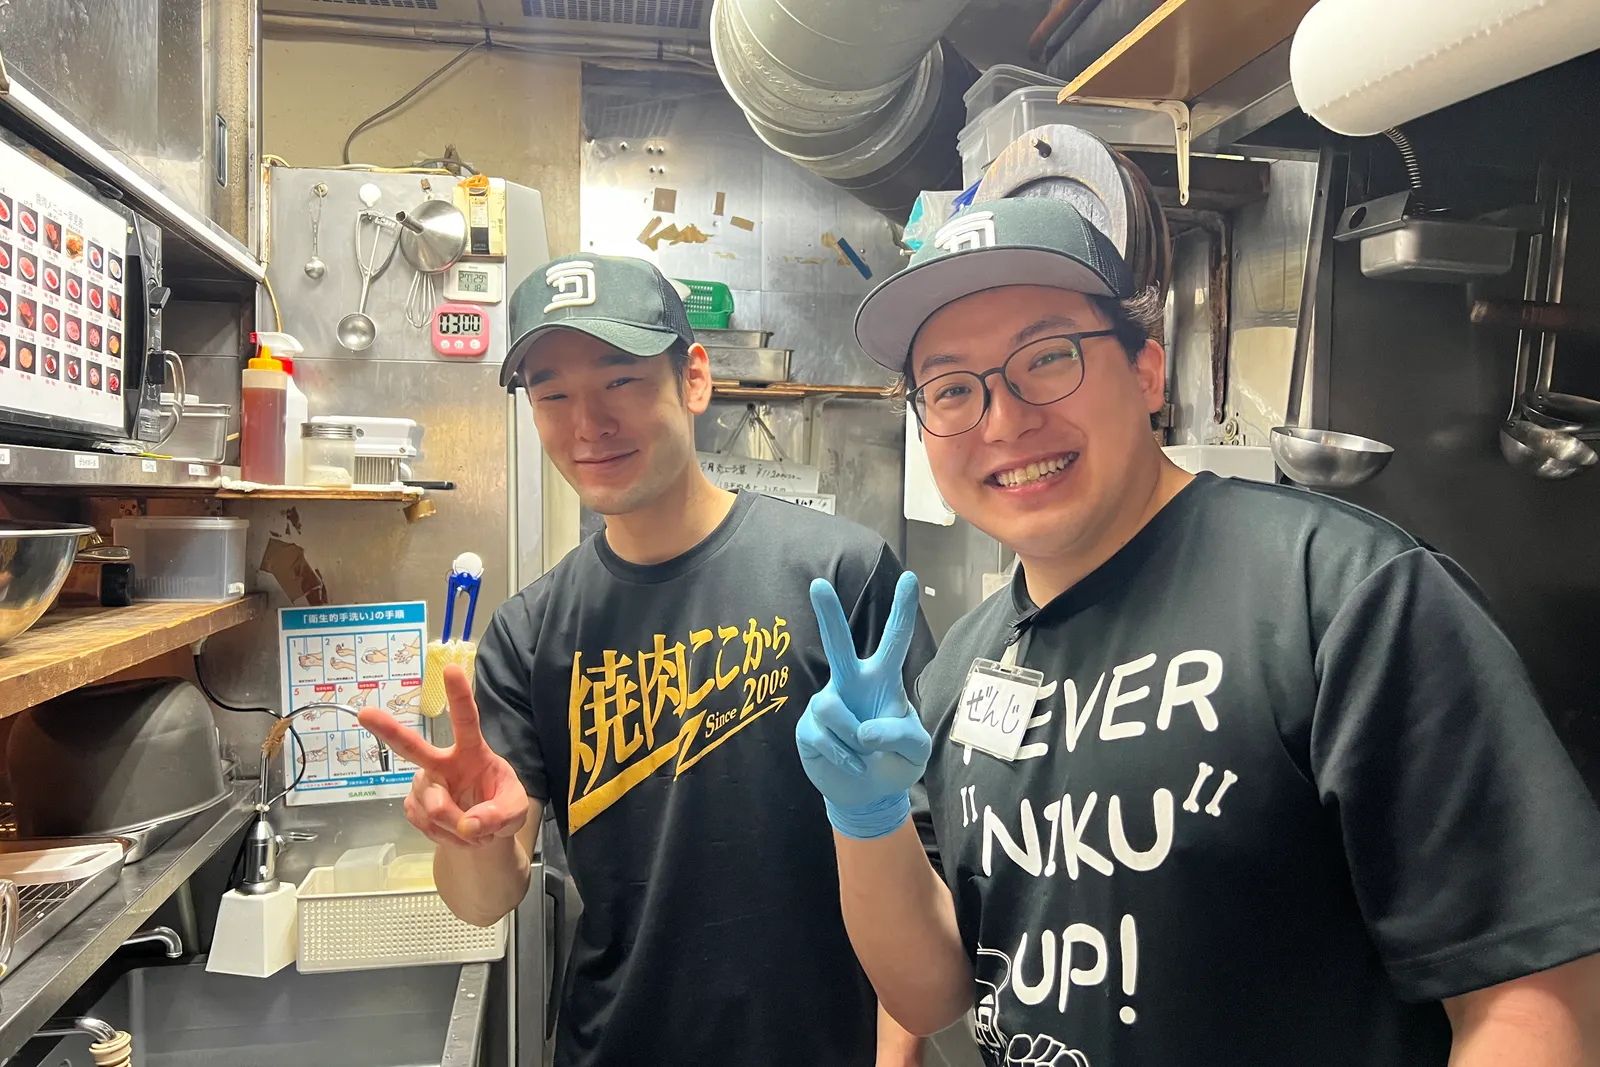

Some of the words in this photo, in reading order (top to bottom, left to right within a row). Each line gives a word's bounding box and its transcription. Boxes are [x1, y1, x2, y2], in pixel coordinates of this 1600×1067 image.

[303, 610, 405, 624] 「衛生的手洗い」の手順
[568, 616, 791, 798] 焼肉ここから
[705, 707, 737, 738] Since
[740, 665, 789, 720] 2008
[962, 649, 1223, 766] EVER
[967, 686, 1020, 734] ぜんじ
[361, 731, 371, 739] 10
[348, 790, 377, 798] SARAYA
[1012, 914, 1139, 1025] UP!
